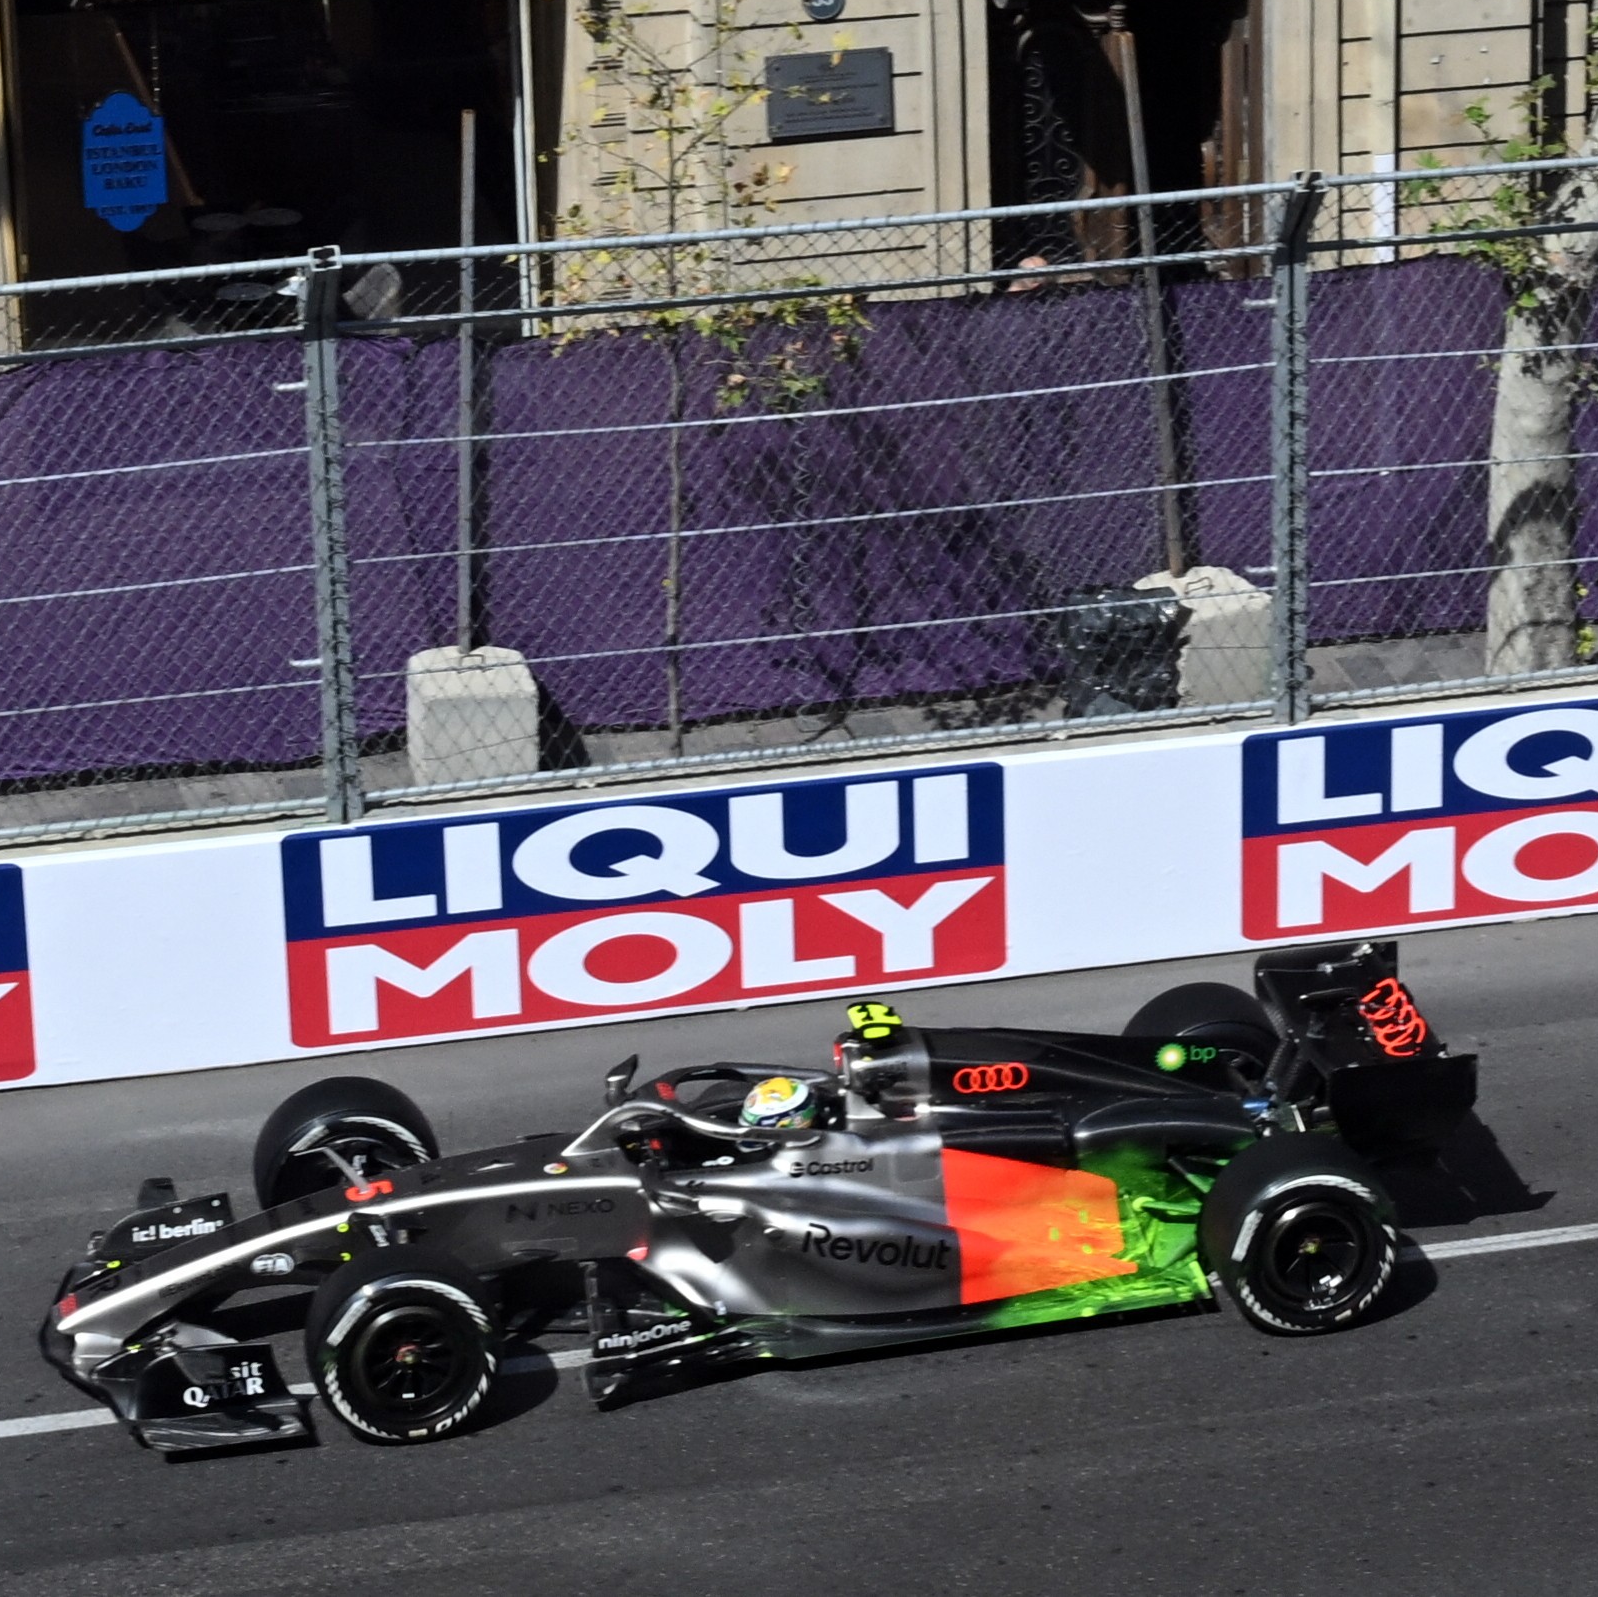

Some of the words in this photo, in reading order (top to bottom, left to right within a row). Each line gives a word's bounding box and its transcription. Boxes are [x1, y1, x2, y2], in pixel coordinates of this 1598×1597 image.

[91, 159, 158, 175] LONDON
[104, 175, 148, 190] BAKU
[320, 773, 970, 927] LIQUI
[325, 876, 996, 1035] MOLY
[1189, 1045, 1217, 1063] bp
[805, 1158, 874, 1176] Castrol
[547, 1199, 614, 1216] NEXO
[132, 1225, 156, 1243] ic!
[802, 1223, 953, 1270] Revolut
[253, 1256, 290, 1273] FIA
[598, 1320, 692, 1349] ninjaOne
[183, 1377, 265, 1408] QATAR
